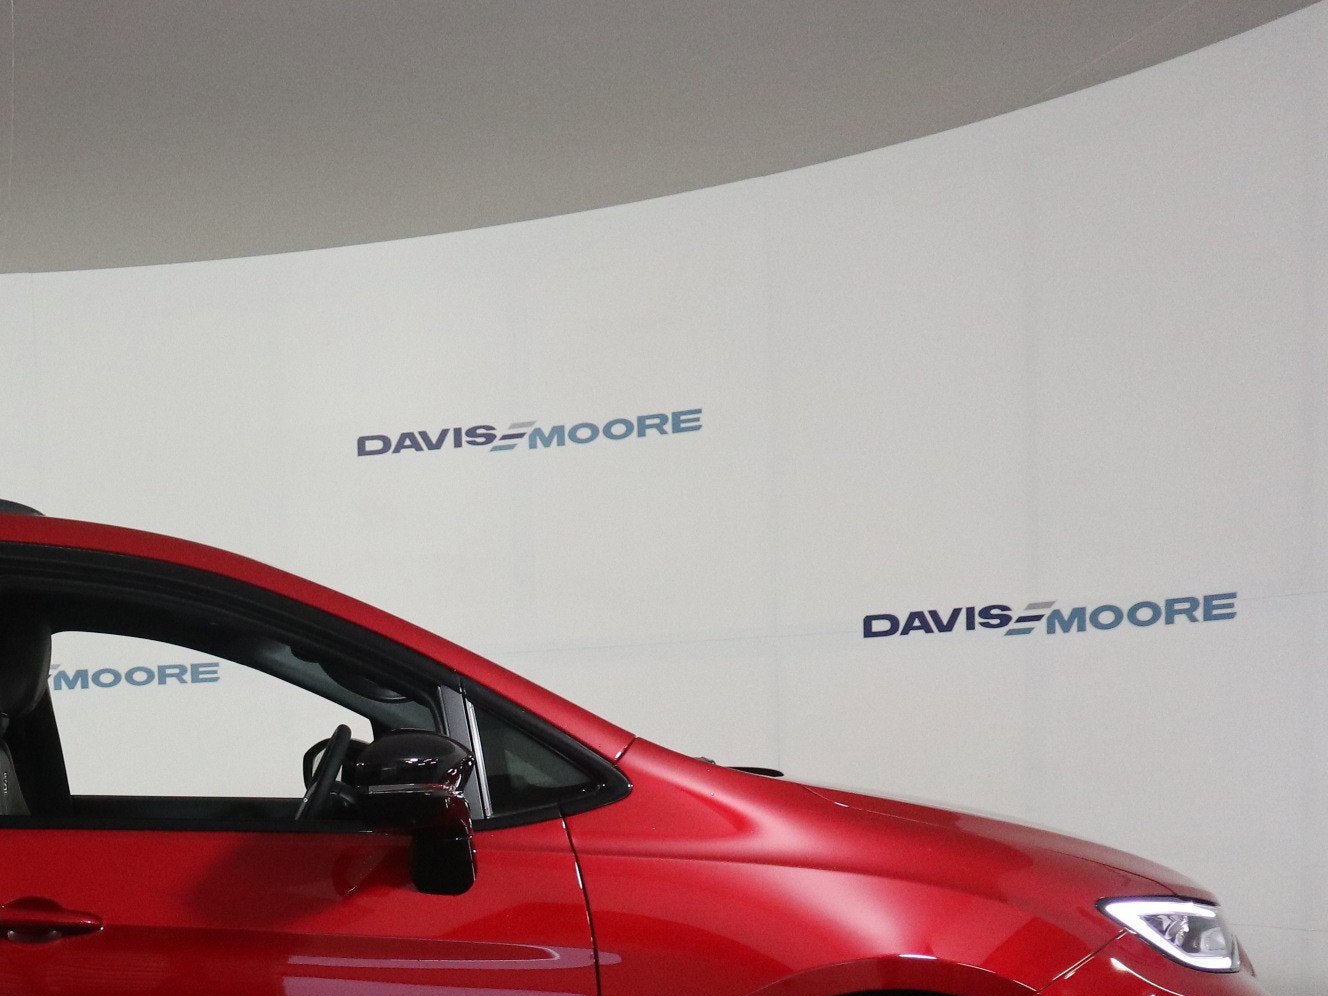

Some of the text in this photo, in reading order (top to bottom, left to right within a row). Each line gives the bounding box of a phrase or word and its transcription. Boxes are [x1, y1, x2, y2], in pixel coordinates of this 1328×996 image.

[356, 408, 703, 457] DAVIS MOORE
[862, 592, 1238, 639] DAVIS MOORE
[53, 661, 221, 691] MOORE
